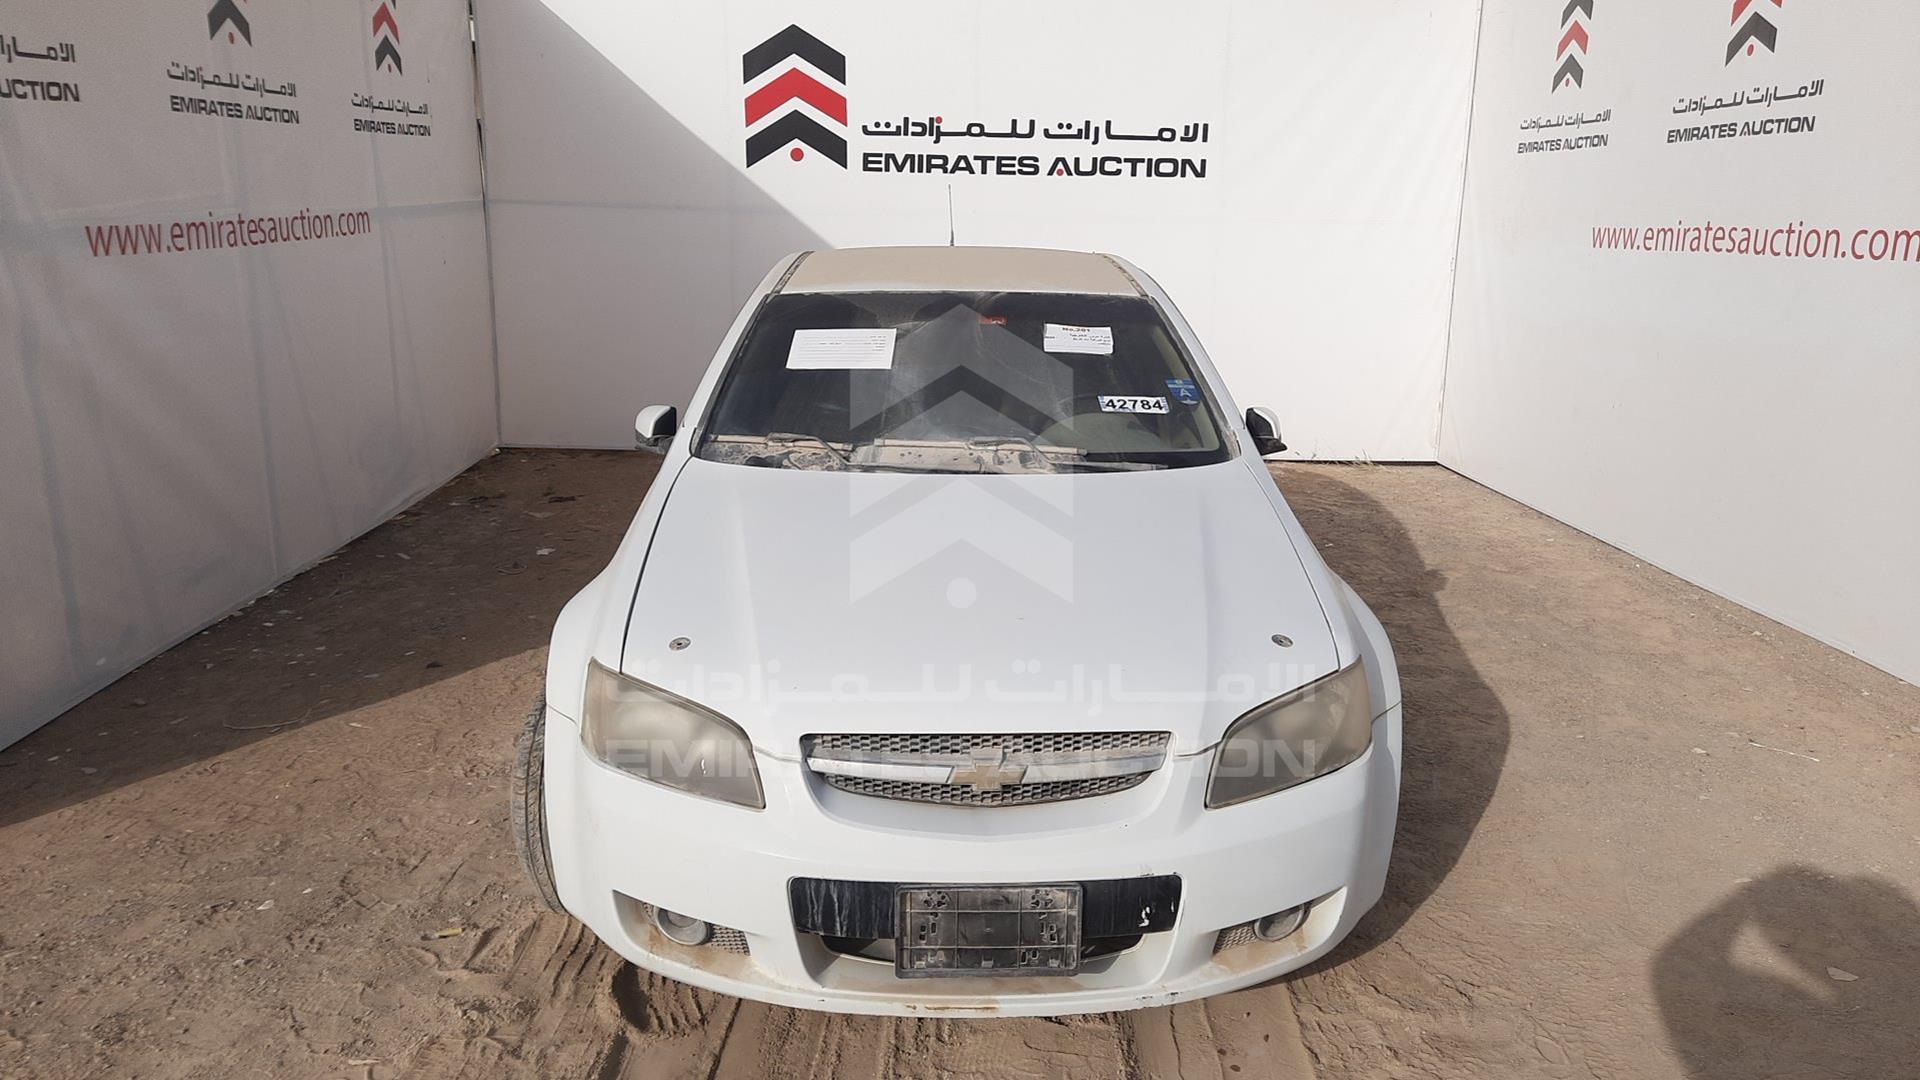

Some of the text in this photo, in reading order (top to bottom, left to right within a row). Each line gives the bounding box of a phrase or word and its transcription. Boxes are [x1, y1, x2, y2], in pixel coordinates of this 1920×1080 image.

[0, 34, 76, 63] الامارا
[0, 78, 80, 102] UCTION
[166, 61, 297, 98] الامارات للمزادات
[169, 94, 300, 124] EMIRATES AUCTION
[1672, 79, 1825, 116] الامارات للمزادات
[353, 118, 431, 137] EMIRATES AUCTION
[861, 116, 1209, 145] الامارات للمزادات
[1667, 115, 1816, 144] EMIRATES AUCTION
[1517, 134, 1609, 154] EMIRATES AUCTION
[862, 152, 1207, 178] EMIRATES AUCTION
[84, 207, 372, 257] www.emiratesauction.com
[1591, 220, 1920, 263] www.emiratesauction.com
[1105, 398, 1164, 411] 42784
